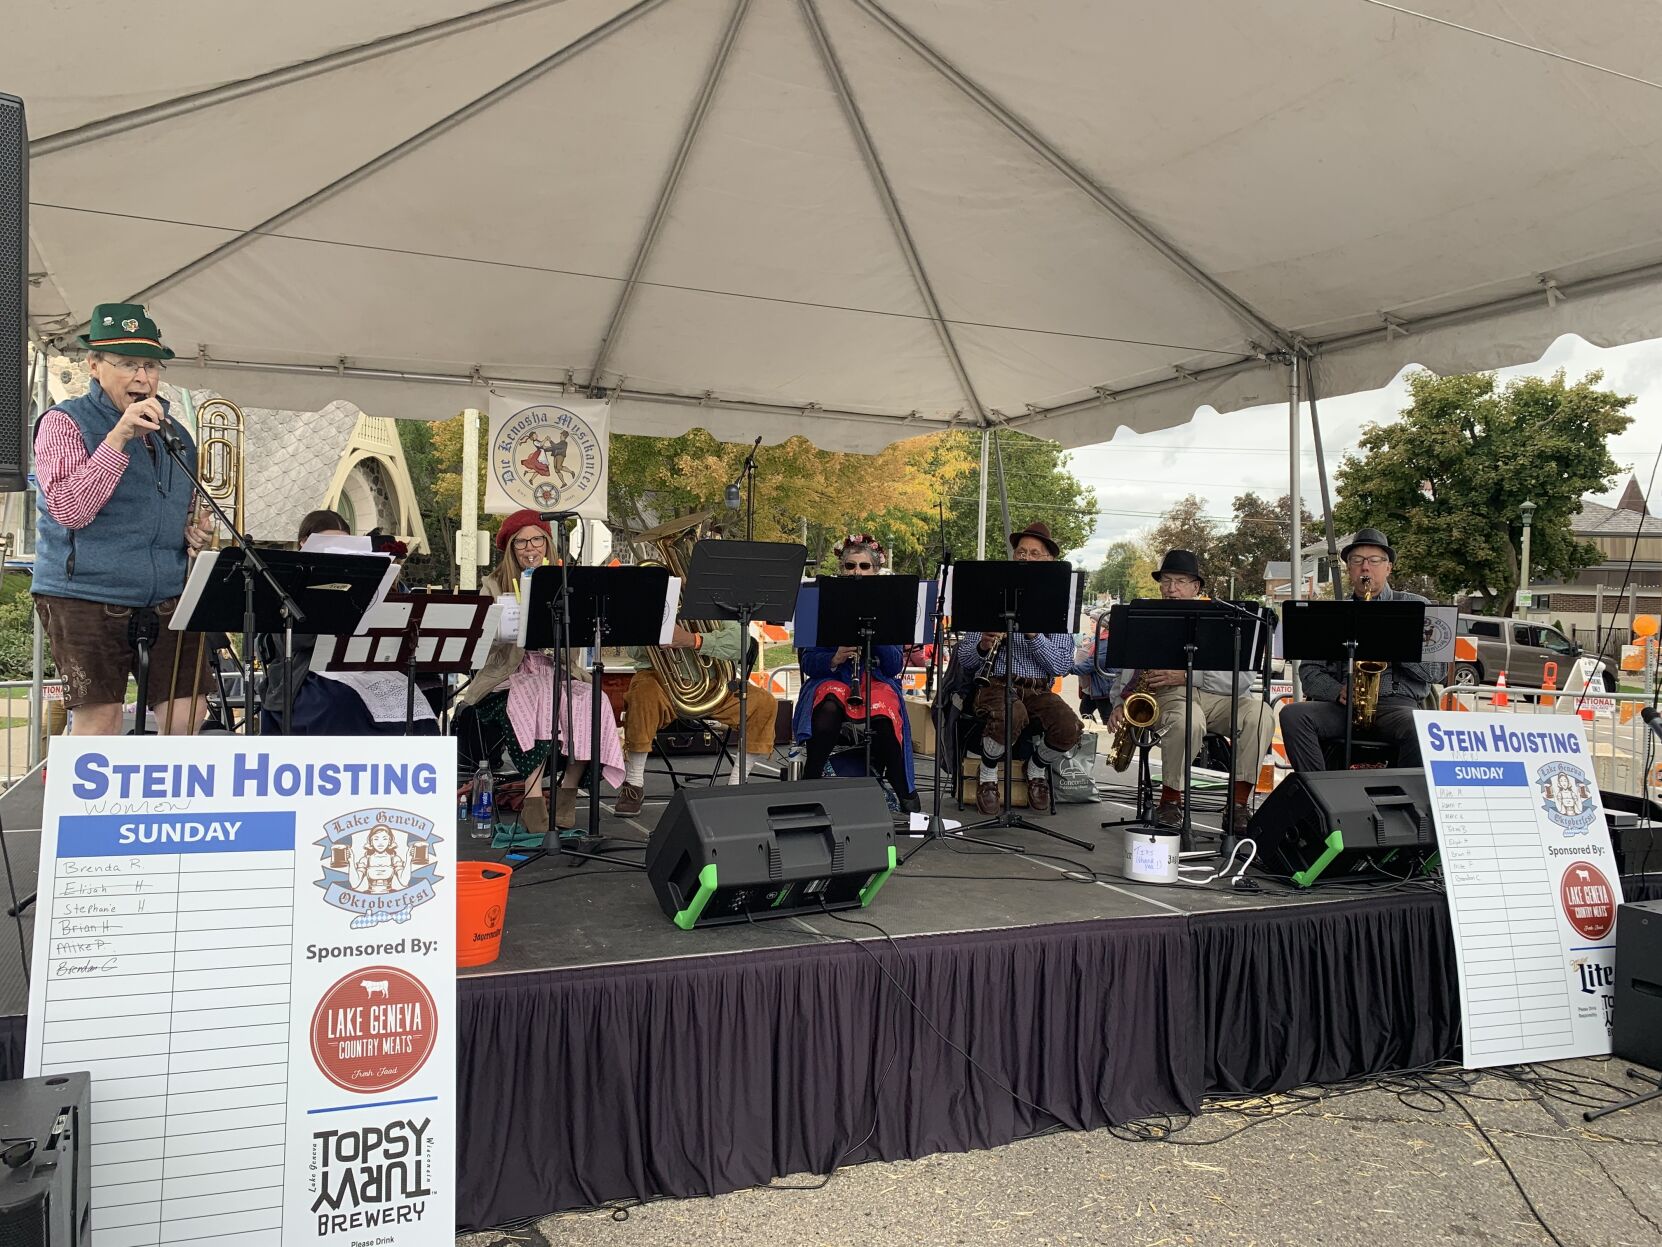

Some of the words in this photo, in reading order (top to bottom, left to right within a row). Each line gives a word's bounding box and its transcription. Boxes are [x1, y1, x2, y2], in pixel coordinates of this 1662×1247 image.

[498, 411, 548, 453] Kenosha
[554, 413, 595, 491] Musikanten
[1576, 698, 1614, 706] NATIONAL
[1428, 722, 1488, 752] STEIN
[1490, 724, 1581, 754] HOISTING
[72, 752, 216, 800] STEIN
[232, 752, 437, 798] HOISTING
[1455, 767, 1504, 779] SUNDAY
[119, 822, 242, 844] SUNDAY
[332, 814, 370, 834] Lake
[375, 810, 426, 831] Geneva
[1548, 844, 1590, 857] Sponsored
[1592, 844, 1605, 856] By:
[63, 861, 121, 874] Brenda
[339, 888, 429, 909] Oktoberfest
[1566, 886, 1584, 905] LAKE
[1584, 885, 1609, 904] GENEVA
[58, 920, 97, 935] Brian
[306, 939, 405, 962] Sponsored
[411, 938, 437, 956] By:
[1577, 963, 1614, 994] Lite
[328, 1007, 364, 1038] LAKE
[370, 1002, 422, 1035] GENEVA
[339, 1038, 379, 1059] COUNTRY
[382, 1035, 413, 1055] MEATS
[313, 1117, 431, 1168] TOPSY
[310, 1159, 431, 1214] TURVY
[318, 1201, 425, 1237] BREWERY
[376, 1236, 394, 1246] Drink
